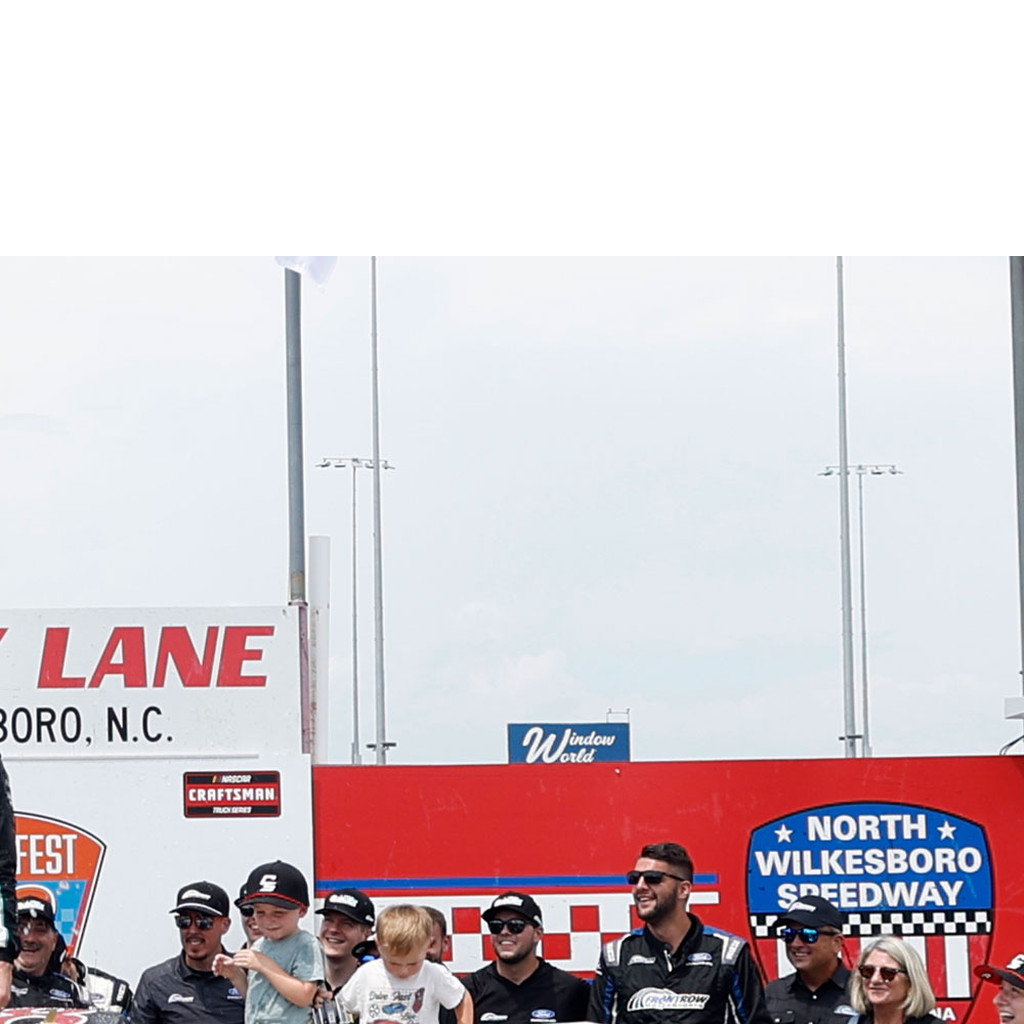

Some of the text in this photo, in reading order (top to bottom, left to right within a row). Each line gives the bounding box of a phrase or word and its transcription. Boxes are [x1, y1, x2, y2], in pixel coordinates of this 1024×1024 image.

[38, 626, 275, 688] LANE
[107, 706, 173, 742] N.C.
[522, 727, 616, 764] Window
[189, 788, 275, 801] CRAFTSMAN
[807, 814, 927, 841] NORTH
[754, 847, 983, 876] WILKESBORO
